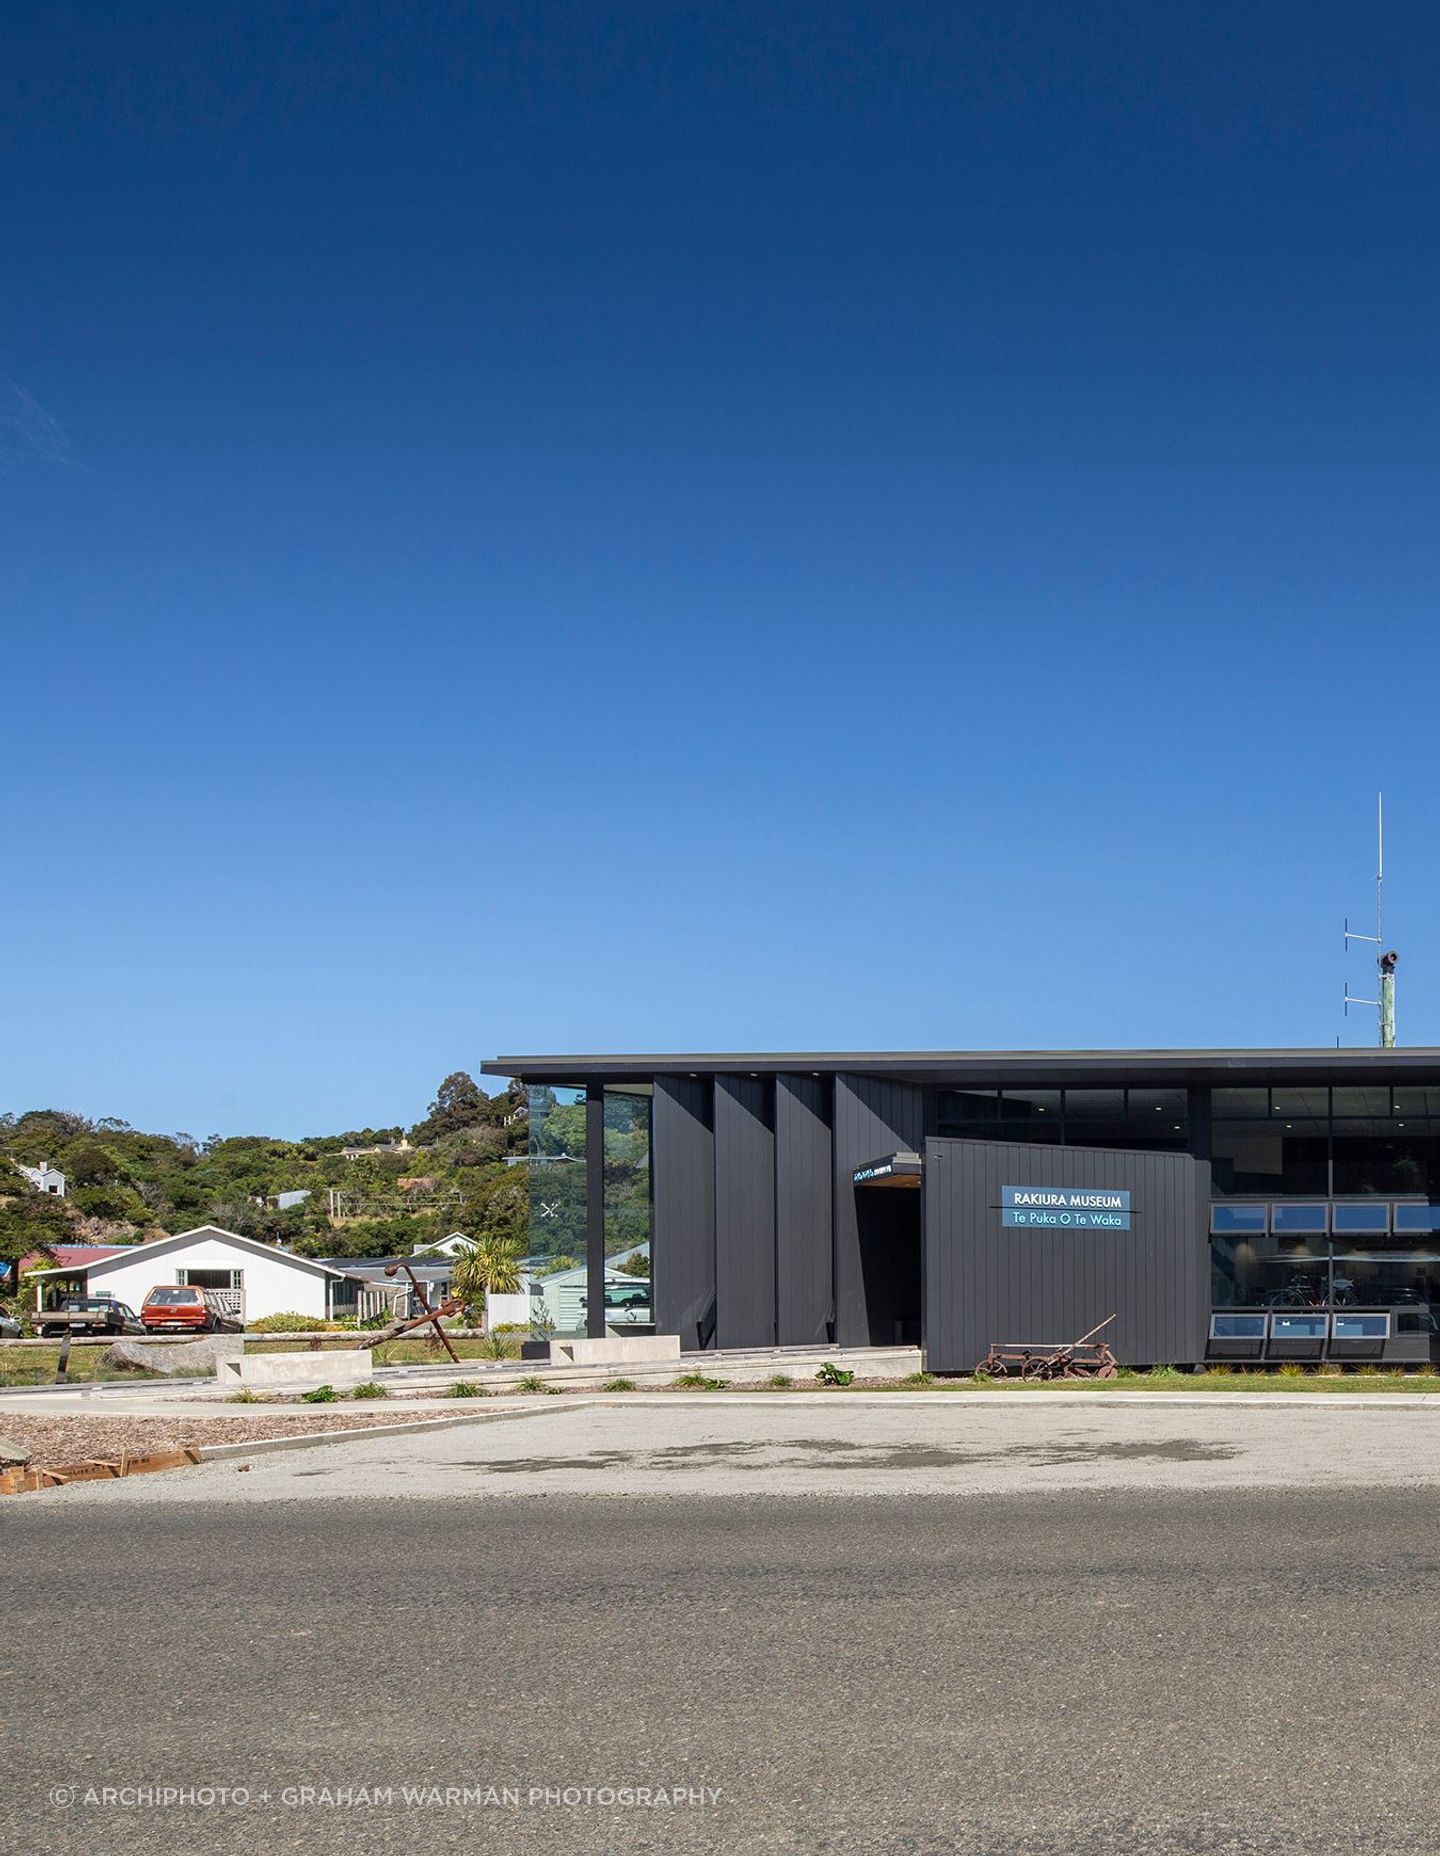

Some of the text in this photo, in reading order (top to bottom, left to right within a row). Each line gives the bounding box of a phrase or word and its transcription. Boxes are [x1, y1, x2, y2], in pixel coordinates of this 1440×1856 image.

[1014, 1193, 1122, 1208] RAKIURA MUSEUM
[1013, 1212, 1122, 1226] Te Puka O Te Waka
